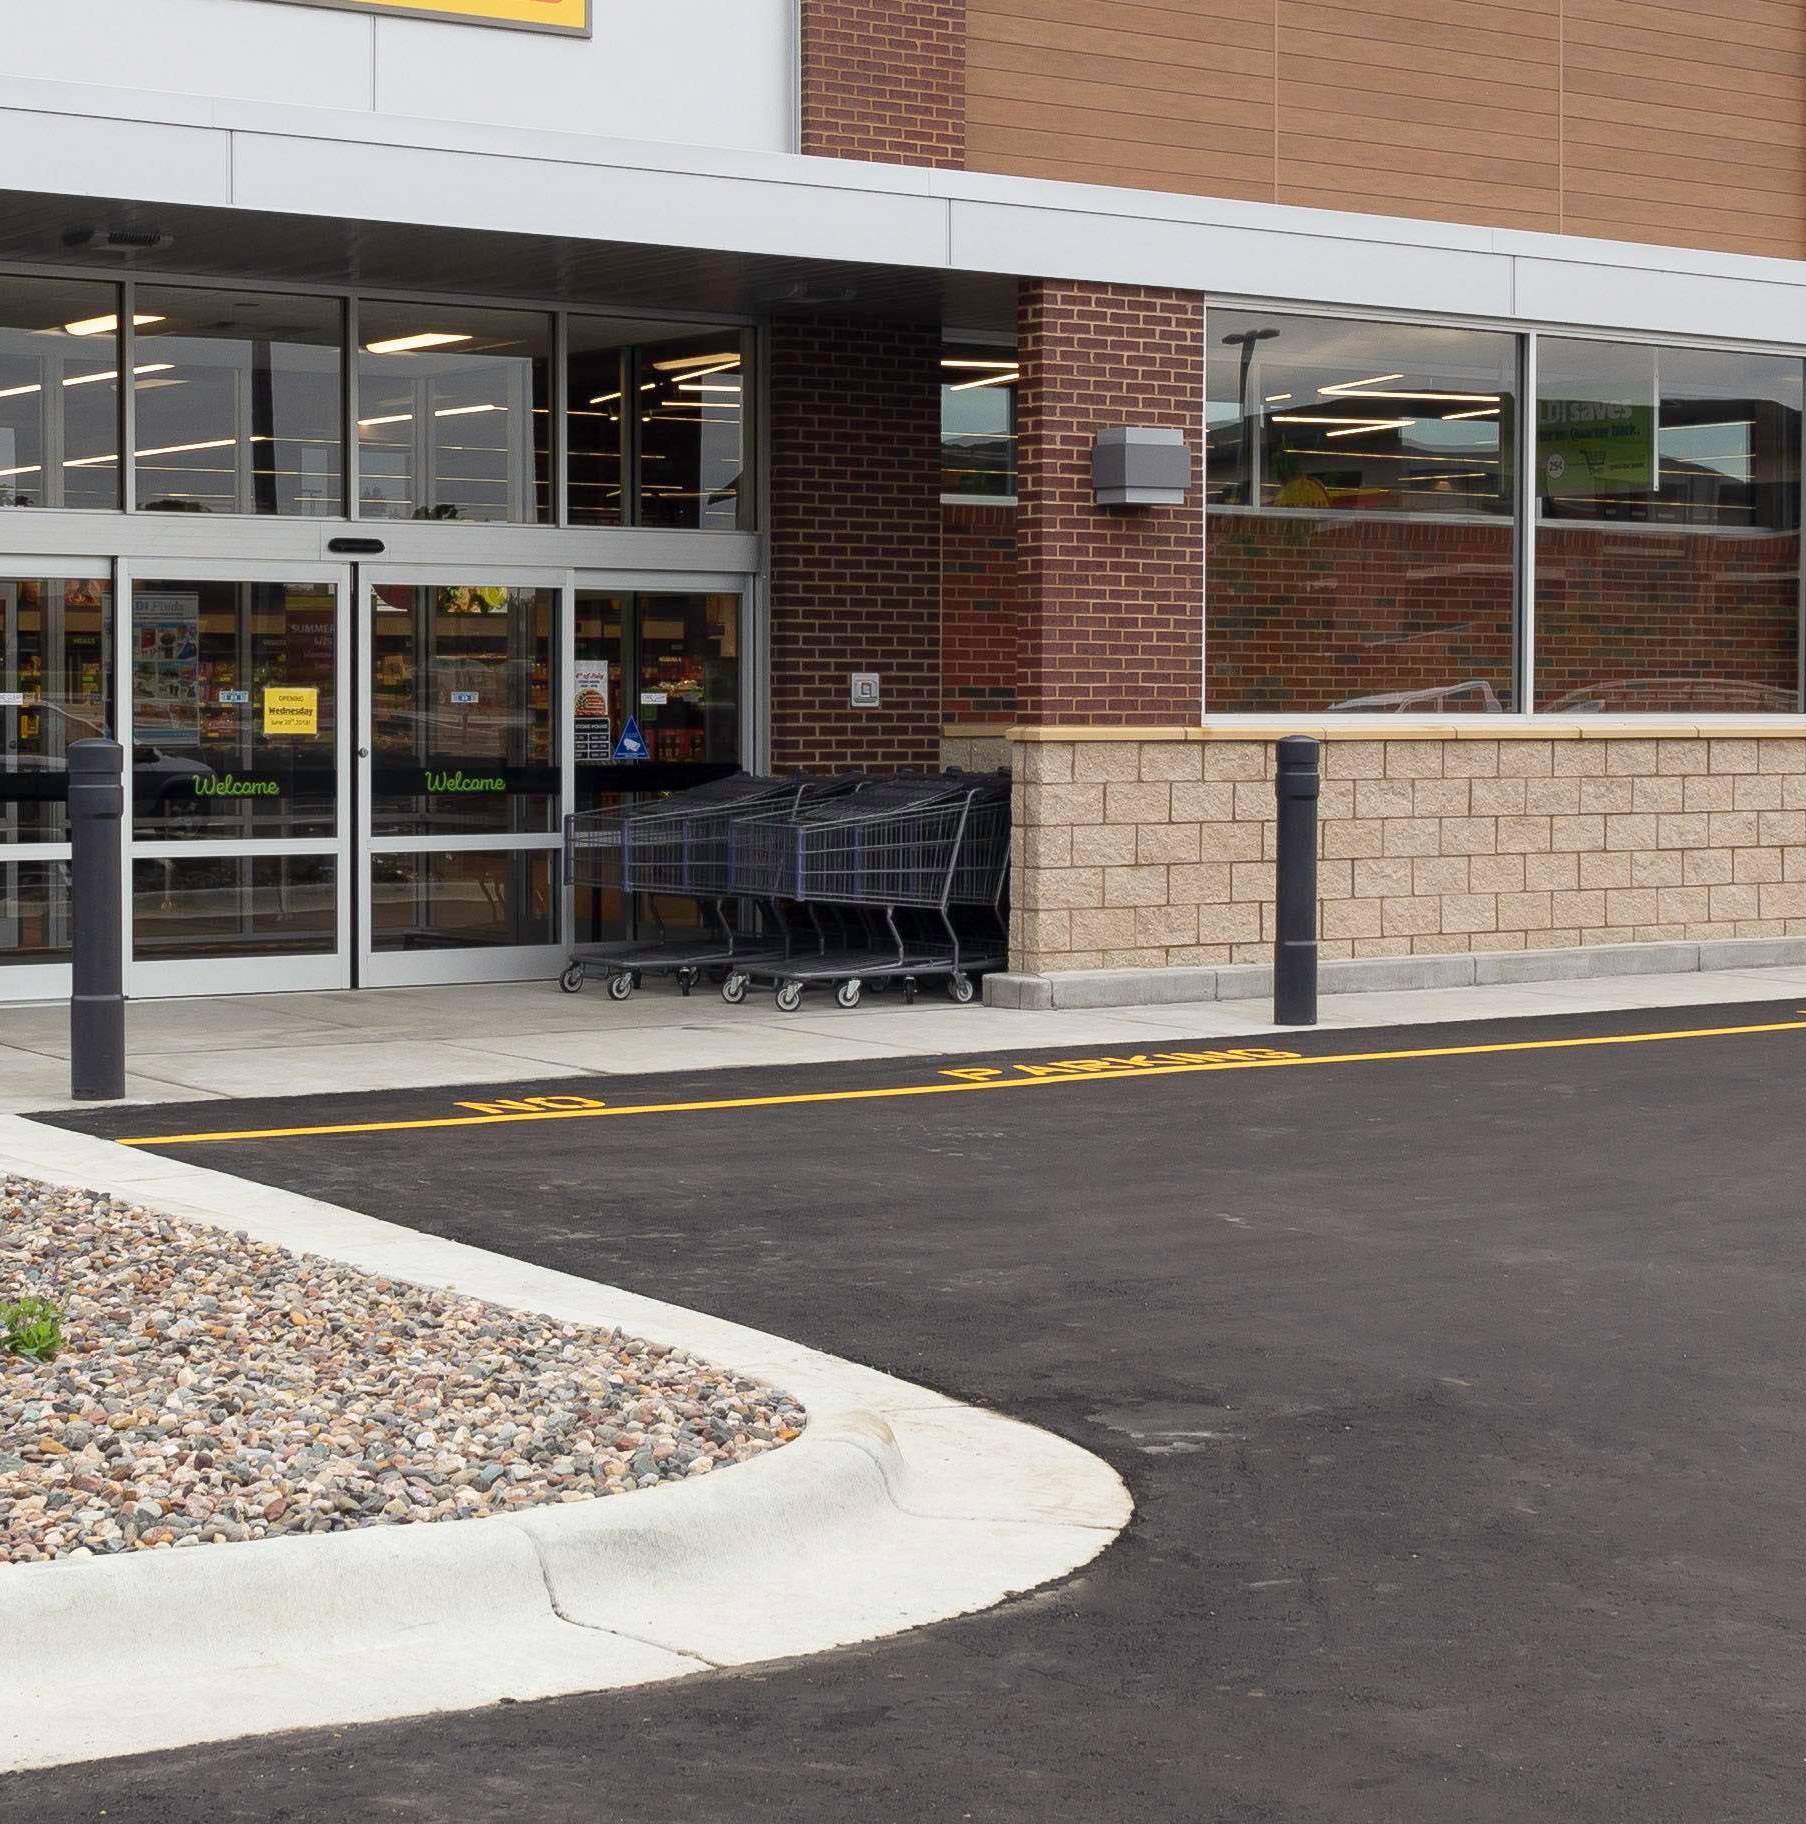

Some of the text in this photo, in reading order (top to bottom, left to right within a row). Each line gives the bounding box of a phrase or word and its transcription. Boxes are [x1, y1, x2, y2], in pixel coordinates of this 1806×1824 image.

[1570, 399, 1632, 423] saves
[268, 706, 314, 717] Wednesday
[193, 774, 281, 796] Welcome
[425, 771, 506, 792] Welcome
[453, 1048, 1302, 1114] NO PARKING
